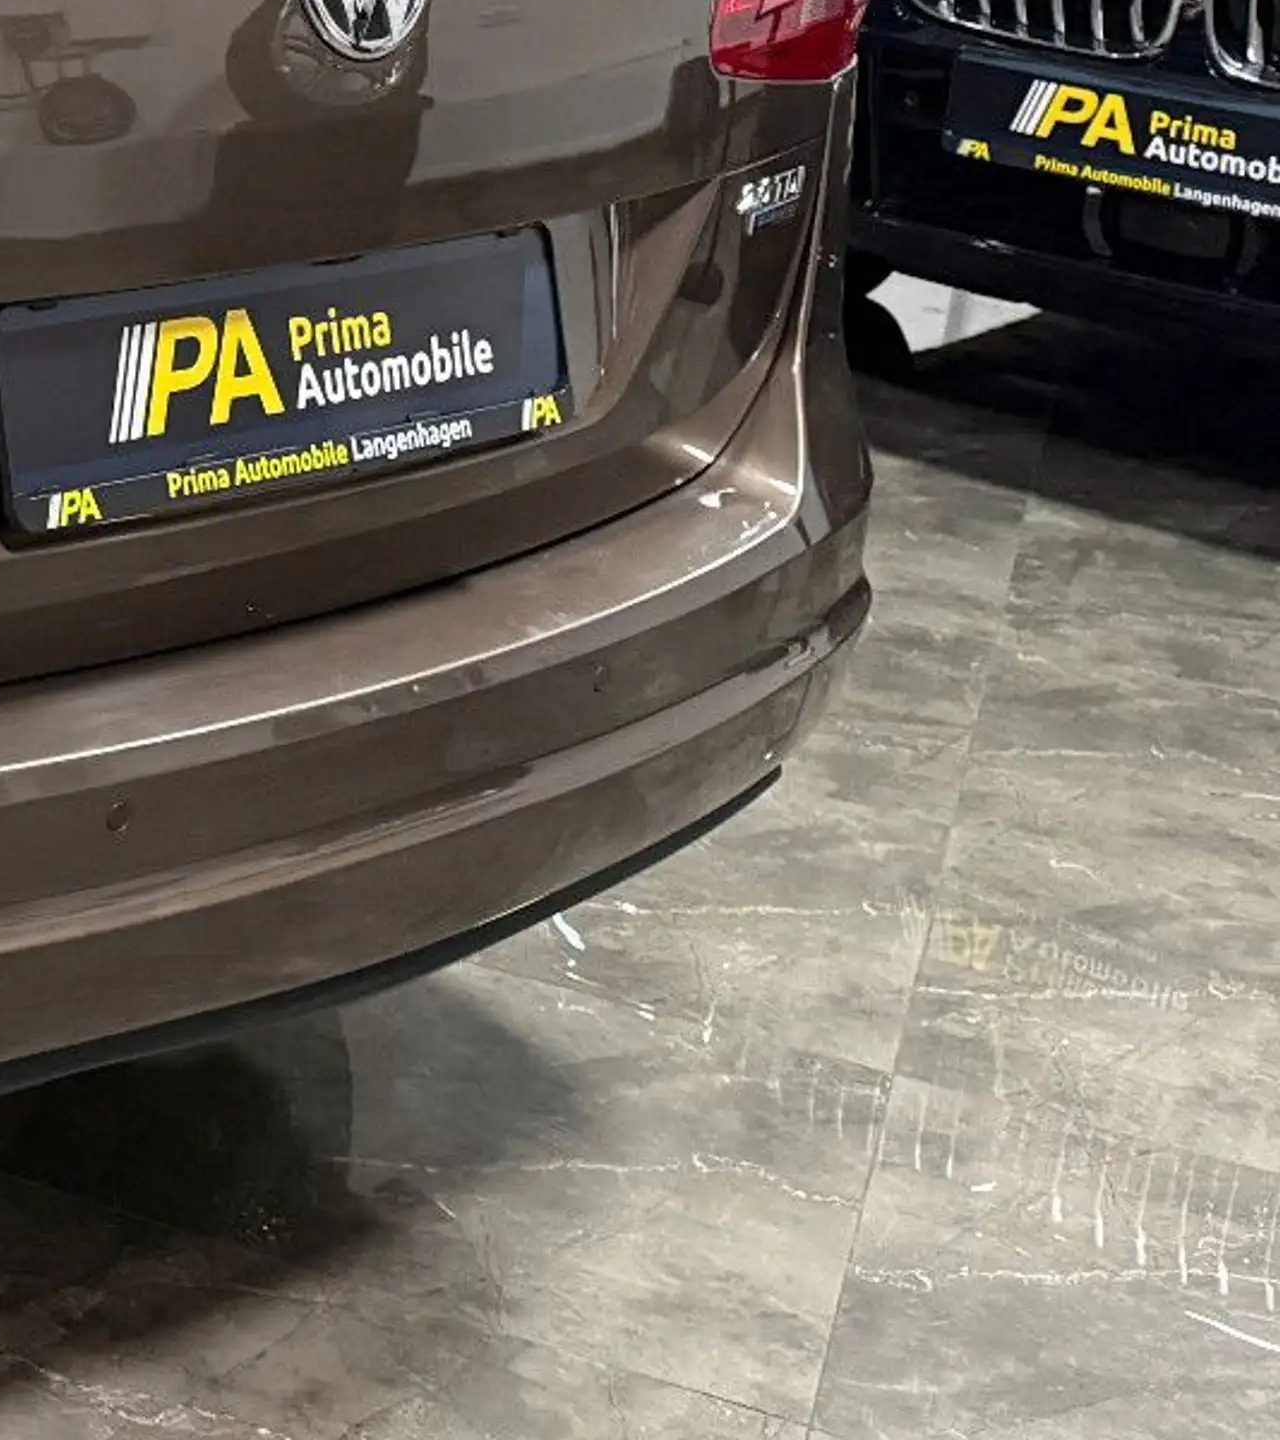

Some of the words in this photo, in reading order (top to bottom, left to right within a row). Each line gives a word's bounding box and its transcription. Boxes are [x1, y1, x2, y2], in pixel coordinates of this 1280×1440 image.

[1036, 84, 1136, 155] PA
[1149, 110, 1237, 150] Prima
[1035, 155, 1079, 178] Prima
[1080, 165, 1171, 197] Automobile
[1173, 181, 1280, 218] Langenhagen
[289, 307, 392, 361] Prima
[296, 329, 494, 410] Automobile
[147, 309, 285, 436] PA
[166, 468, 230, 498] Prima
[234, 440, 349, 486] Automobile
[350, 418, 473, 462] Langenhagen
